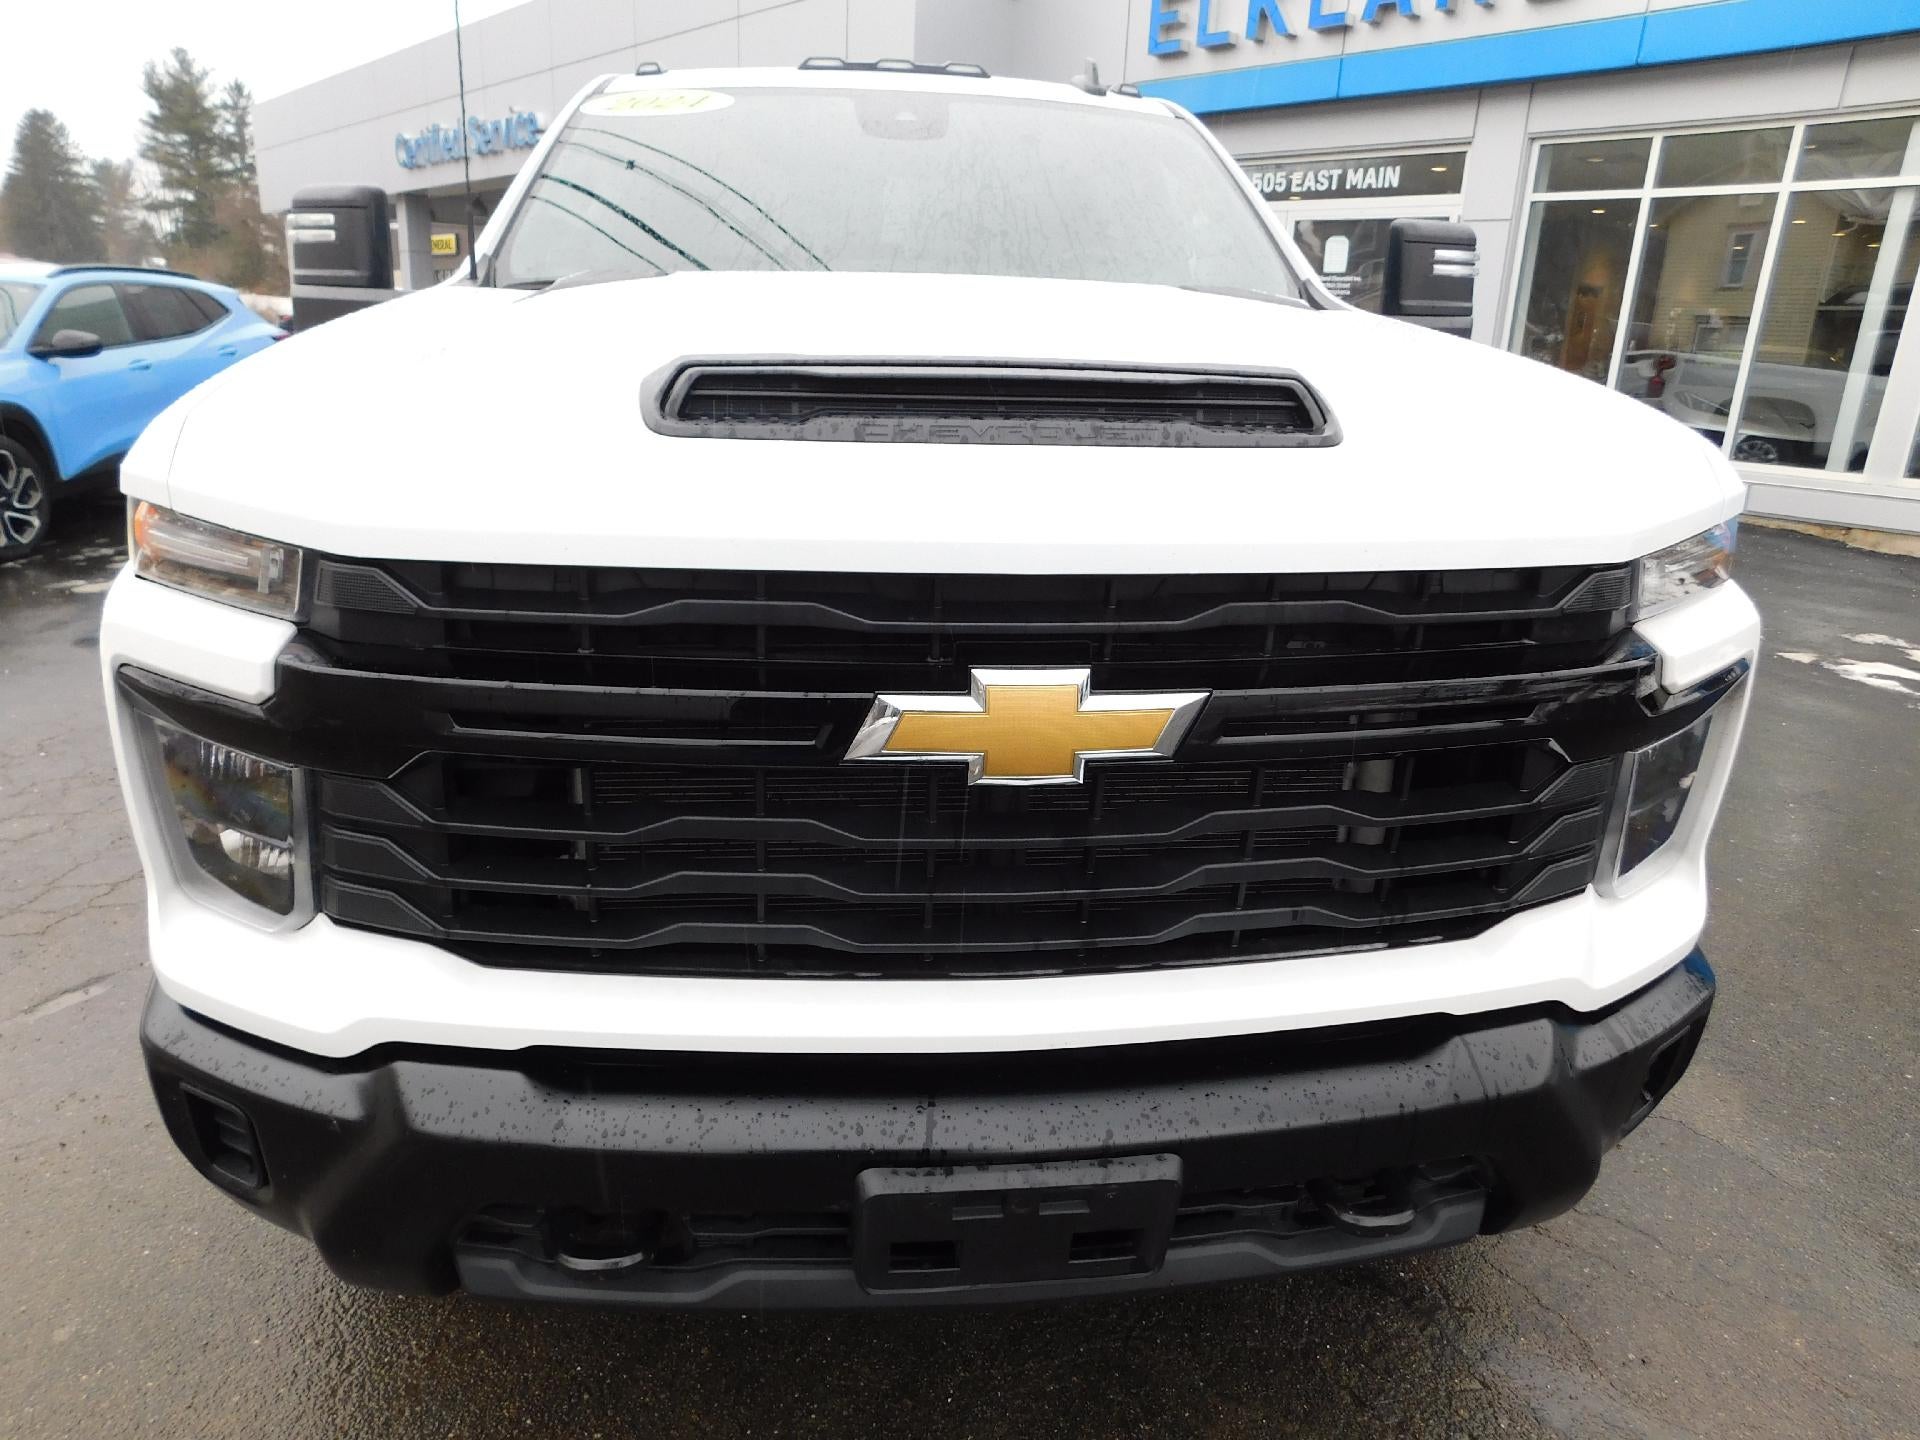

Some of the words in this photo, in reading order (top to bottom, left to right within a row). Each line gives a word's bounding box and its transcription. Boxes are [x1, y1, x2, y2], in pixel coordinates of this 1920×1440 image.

[395, 118, 466, 169] Certified
[467, 112, 543, 155] Service
[1251, 171, 1287, 194] 505
[1291, 168, 1342, 192] EAST
[1346, 165, 1401, 189] MAIN
